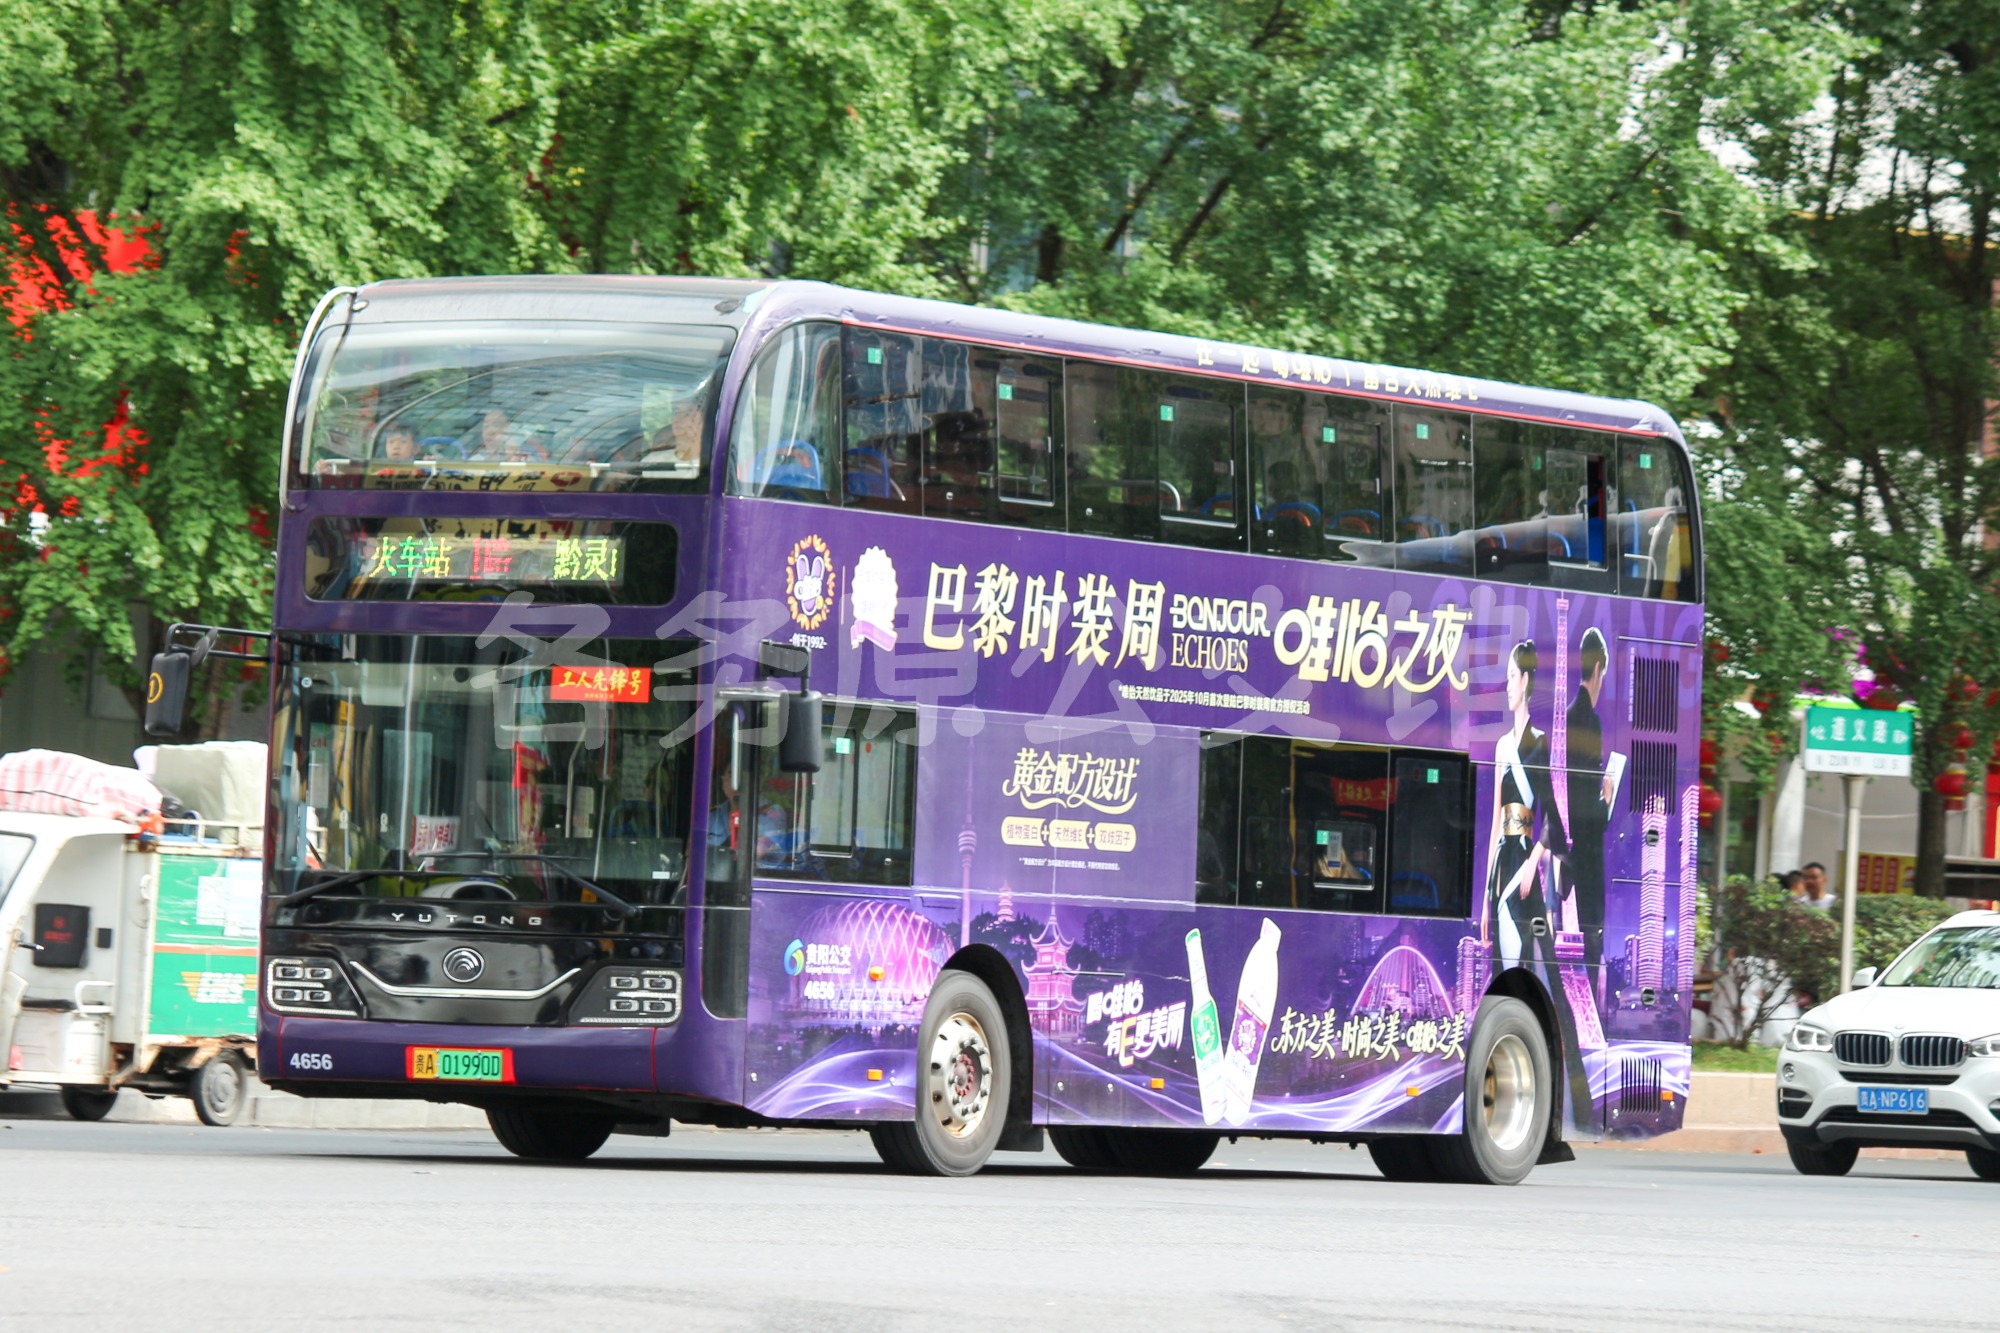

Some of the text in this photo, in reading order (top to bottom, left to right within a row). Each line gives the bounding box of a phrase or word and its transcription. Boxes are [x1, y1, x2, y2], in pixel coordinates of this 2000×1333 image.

[369, 536, 452, 578] 火车站
[922, 562, 1166, 671] 巴黎时装周
[1169, 594, 1271, 638] BONJOUR
[1171, 633, 1249, 673] ECHOES
[559, 669, 642, 696] 工人先锋号
[1007, 823, 1039, 841] 植物蛋白
[392, 912, 543, 927] YUTONG
[806, 943, 852, 966] 贵阳公交
[804, 980, 836, 1000] 4656
[1103, 1001, 1187, 1067] 有E更美丽
[290, 1053, 333, 1070] 4656
